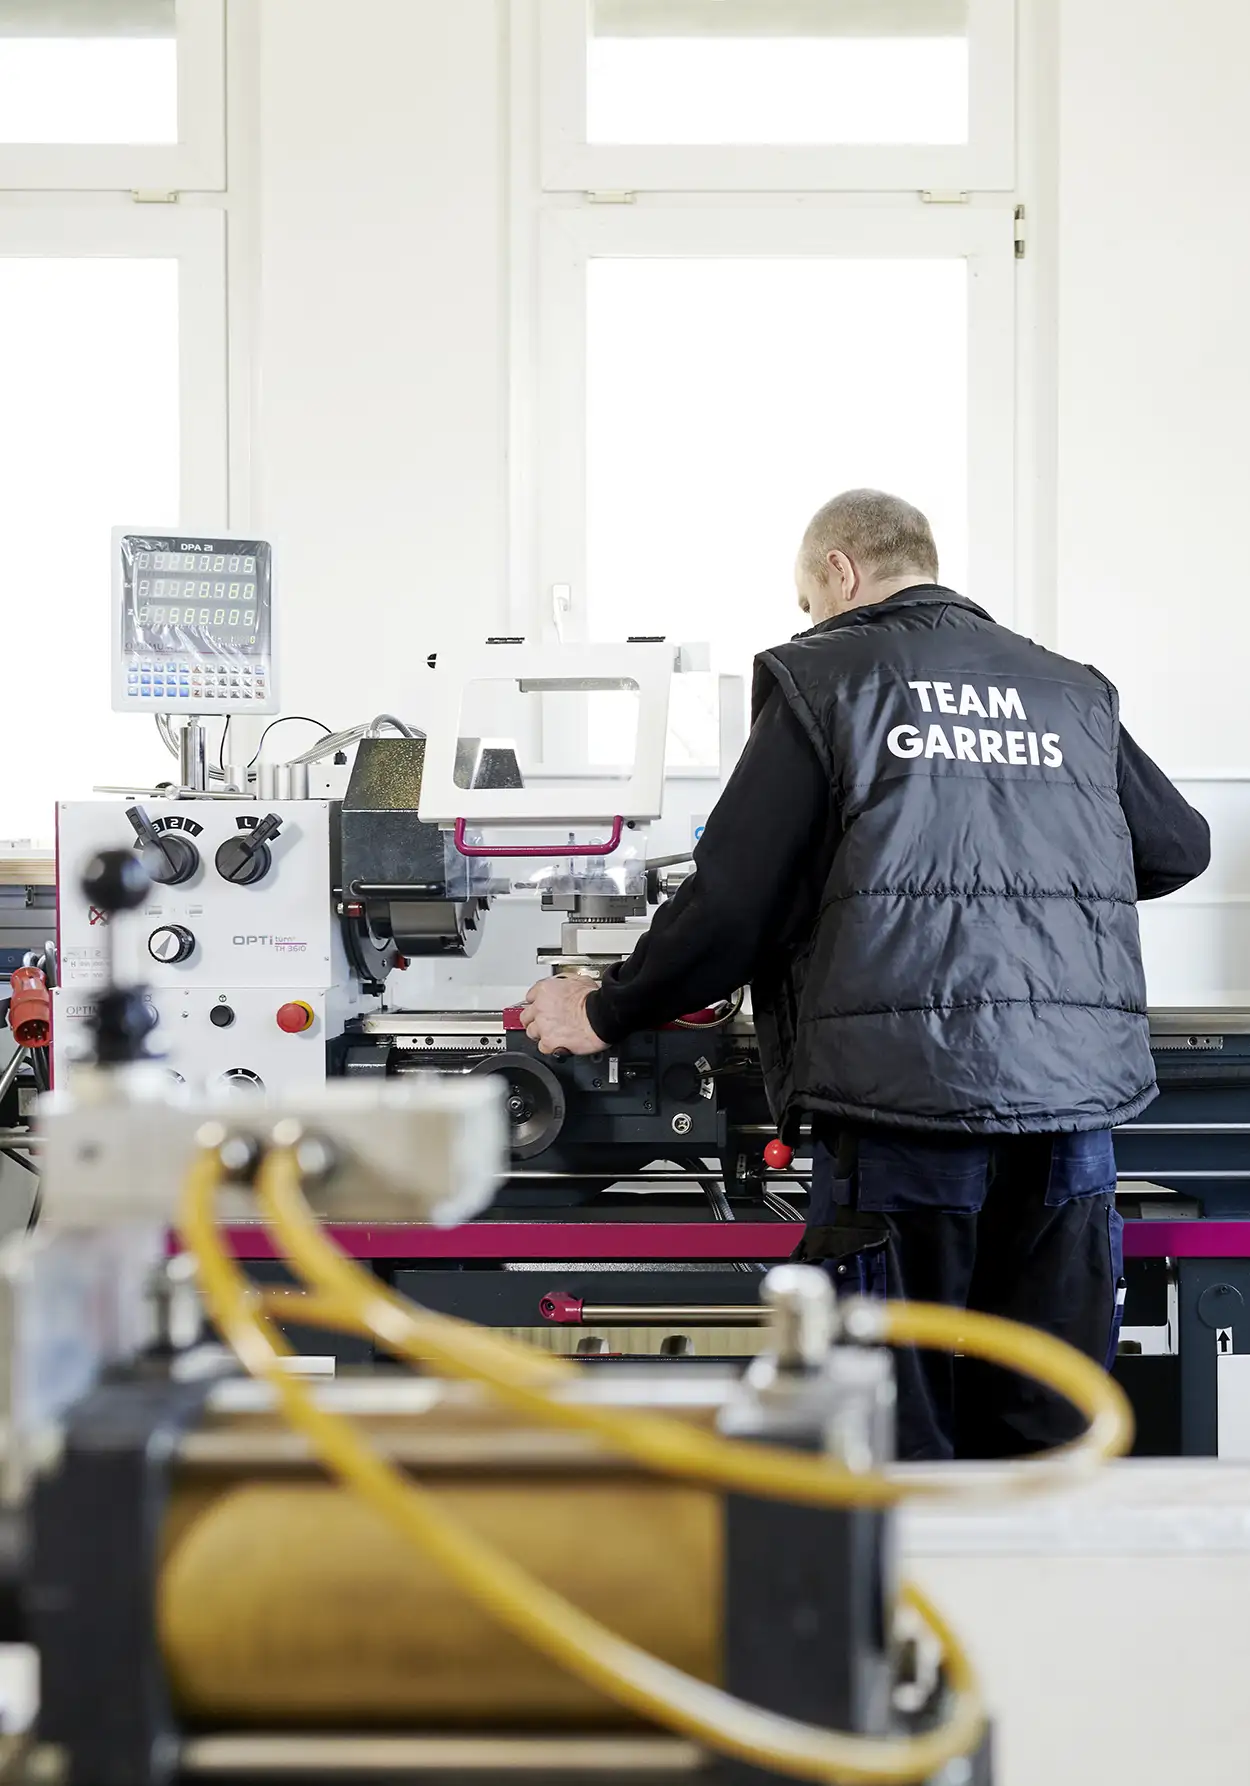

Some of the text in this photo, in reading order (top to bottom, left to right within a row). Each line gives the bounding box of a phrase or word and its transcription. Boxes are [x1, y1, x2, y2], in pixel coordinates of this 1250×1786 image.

[181, 543, 201, 551] DPA
[908, 681, 1028, 720] TEAM
[886, 724, 1063, 768] GARREIS
[170, 818, 180, 828] 2
